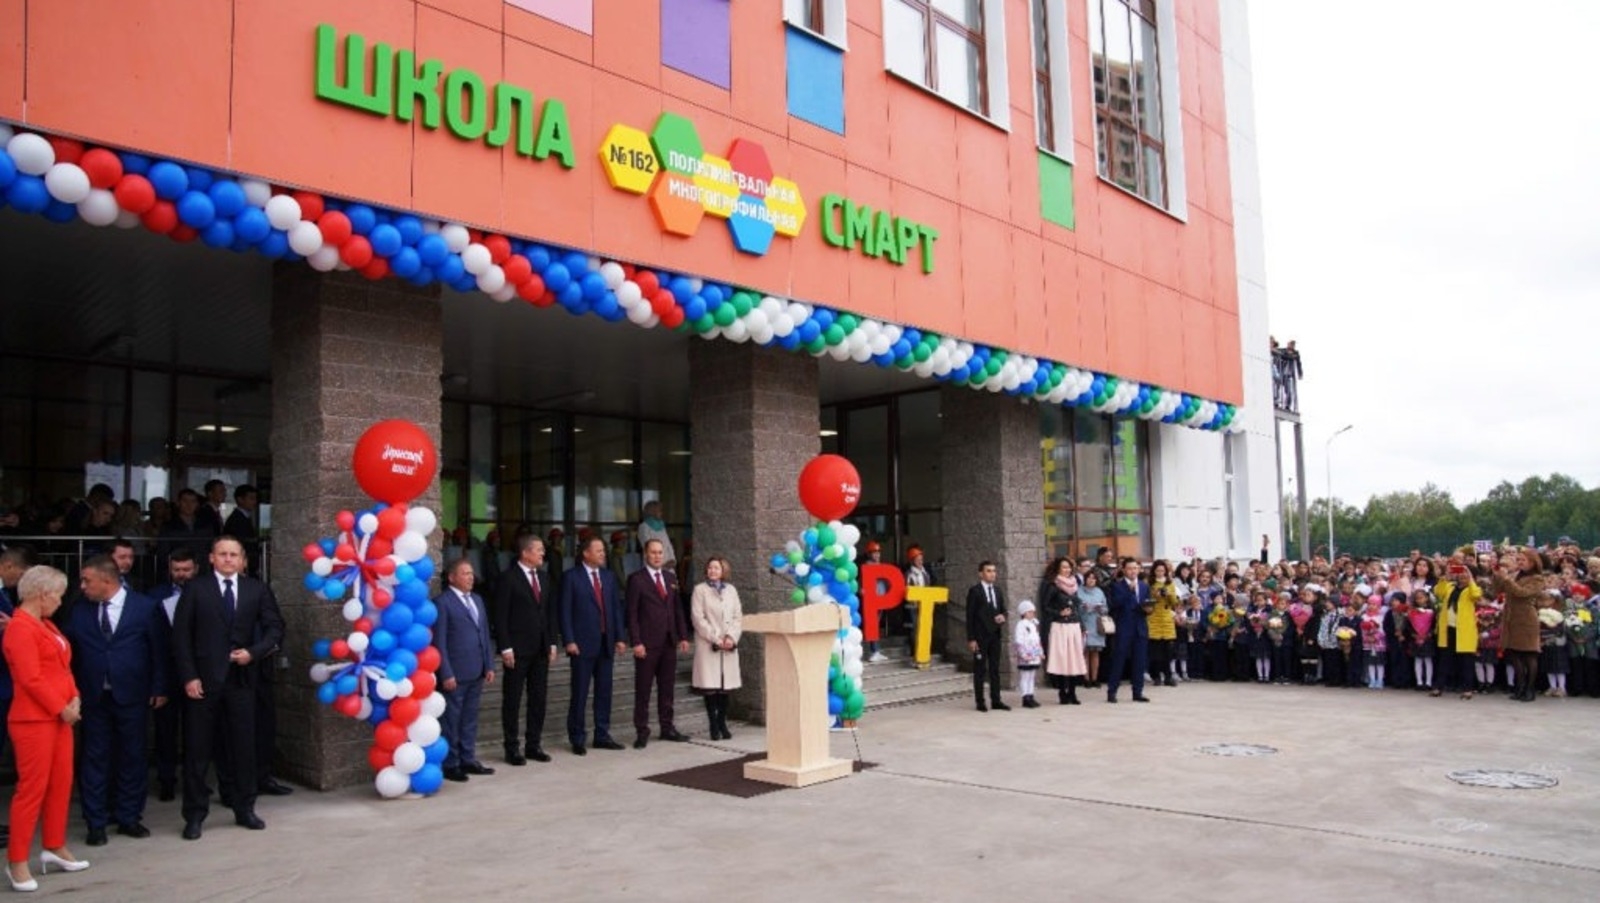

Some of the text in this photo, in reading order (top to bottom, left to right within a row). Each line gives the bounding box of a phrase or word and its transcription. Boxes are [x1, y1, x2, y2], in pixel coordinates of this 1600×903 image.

[316, 23, 575, 169] ШКОЛА
[610, 144, 654, 174] №162
[820, 192, 939, 275] СМАРТ
